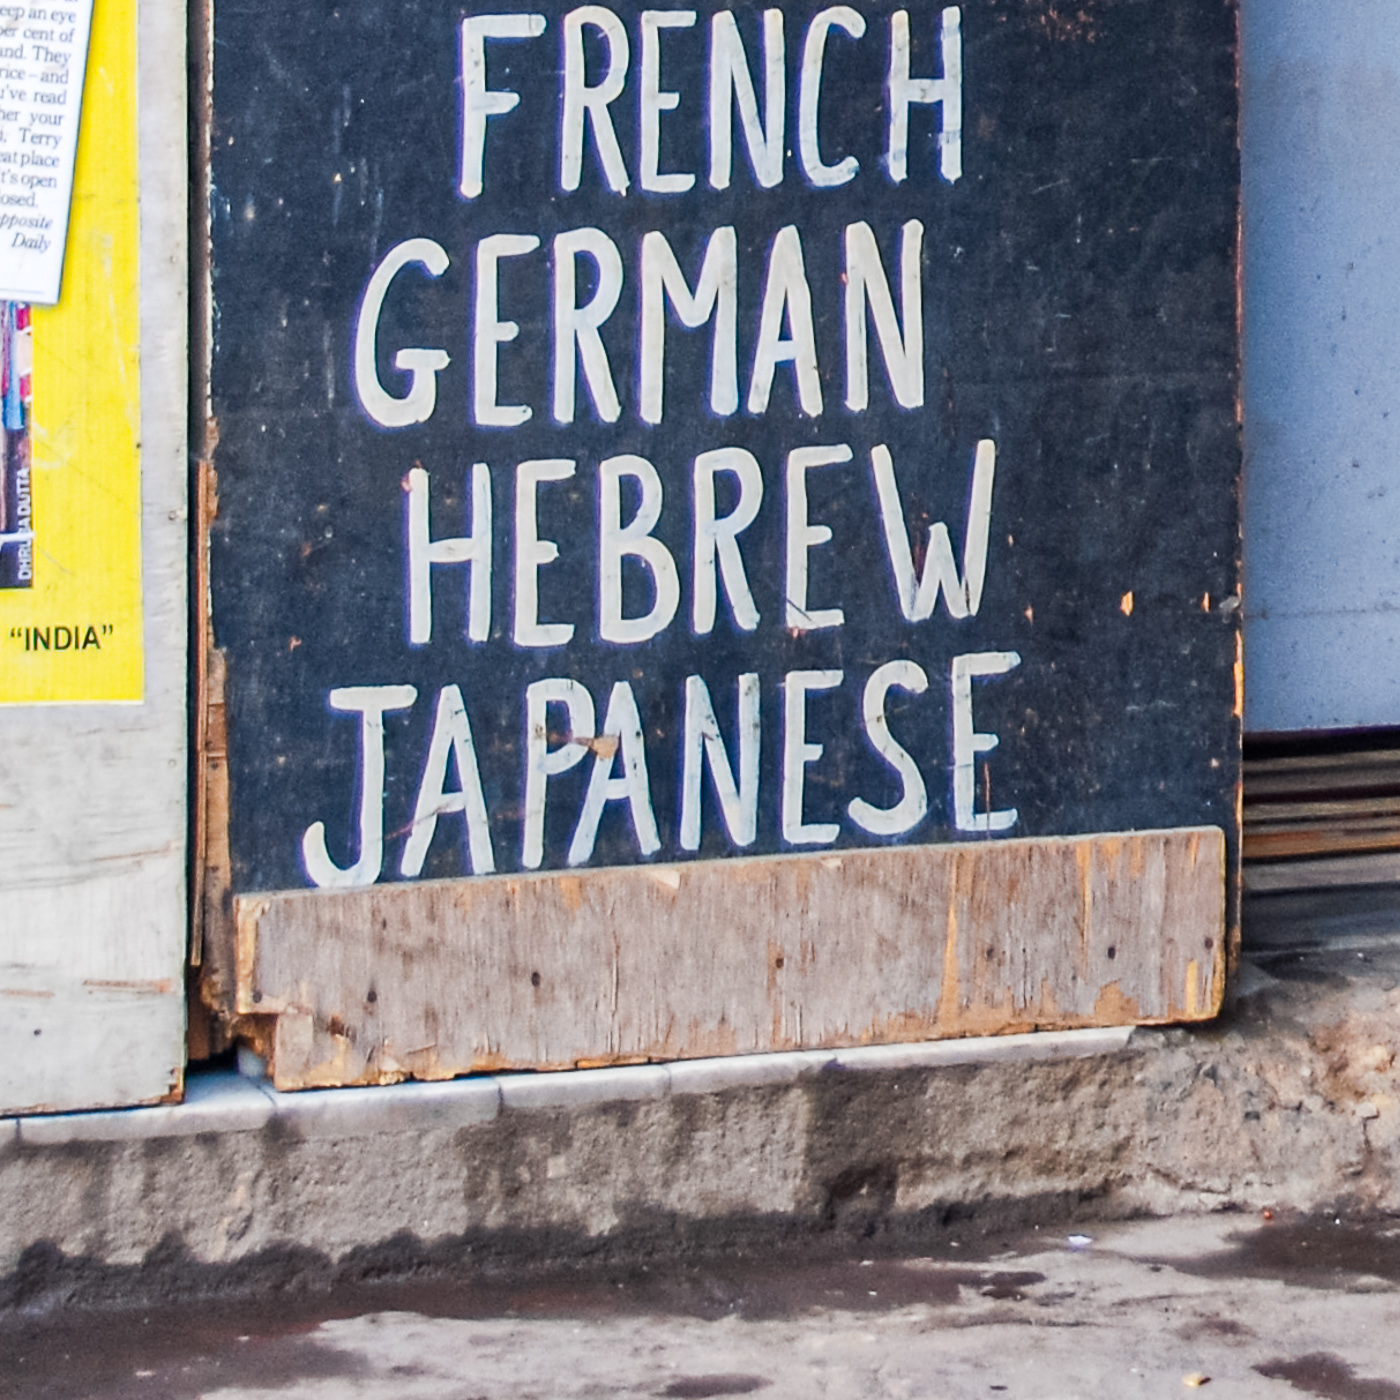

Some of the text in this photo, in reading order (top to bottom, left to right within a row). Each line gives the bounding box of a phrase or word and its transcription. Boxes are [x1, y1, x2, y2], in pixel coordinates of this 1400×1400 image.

[28, 7, 47, 20] an
[50, 9, 77, 25] eye
[23, 27, 55, 42] cent
[59, 27, 76, 44] of
[32, 45, 72, 68] They
[40, 68, 69, 85] and
[34, 89, 67, 105] read
[459, 4, 963, 198] FRENCH
[29, 111, 65, 127] your
[19, 127, 62, 150] Terry
[20, 150, 60, 168] place
[21, 174, 57, 189] open
[11, 232, 52, 254] Daily
[353, 218, 924, 428] GERMAN
[407, 437, 996, 648] HEBREW
[302, 649, 1021, 889] JAPANESE
